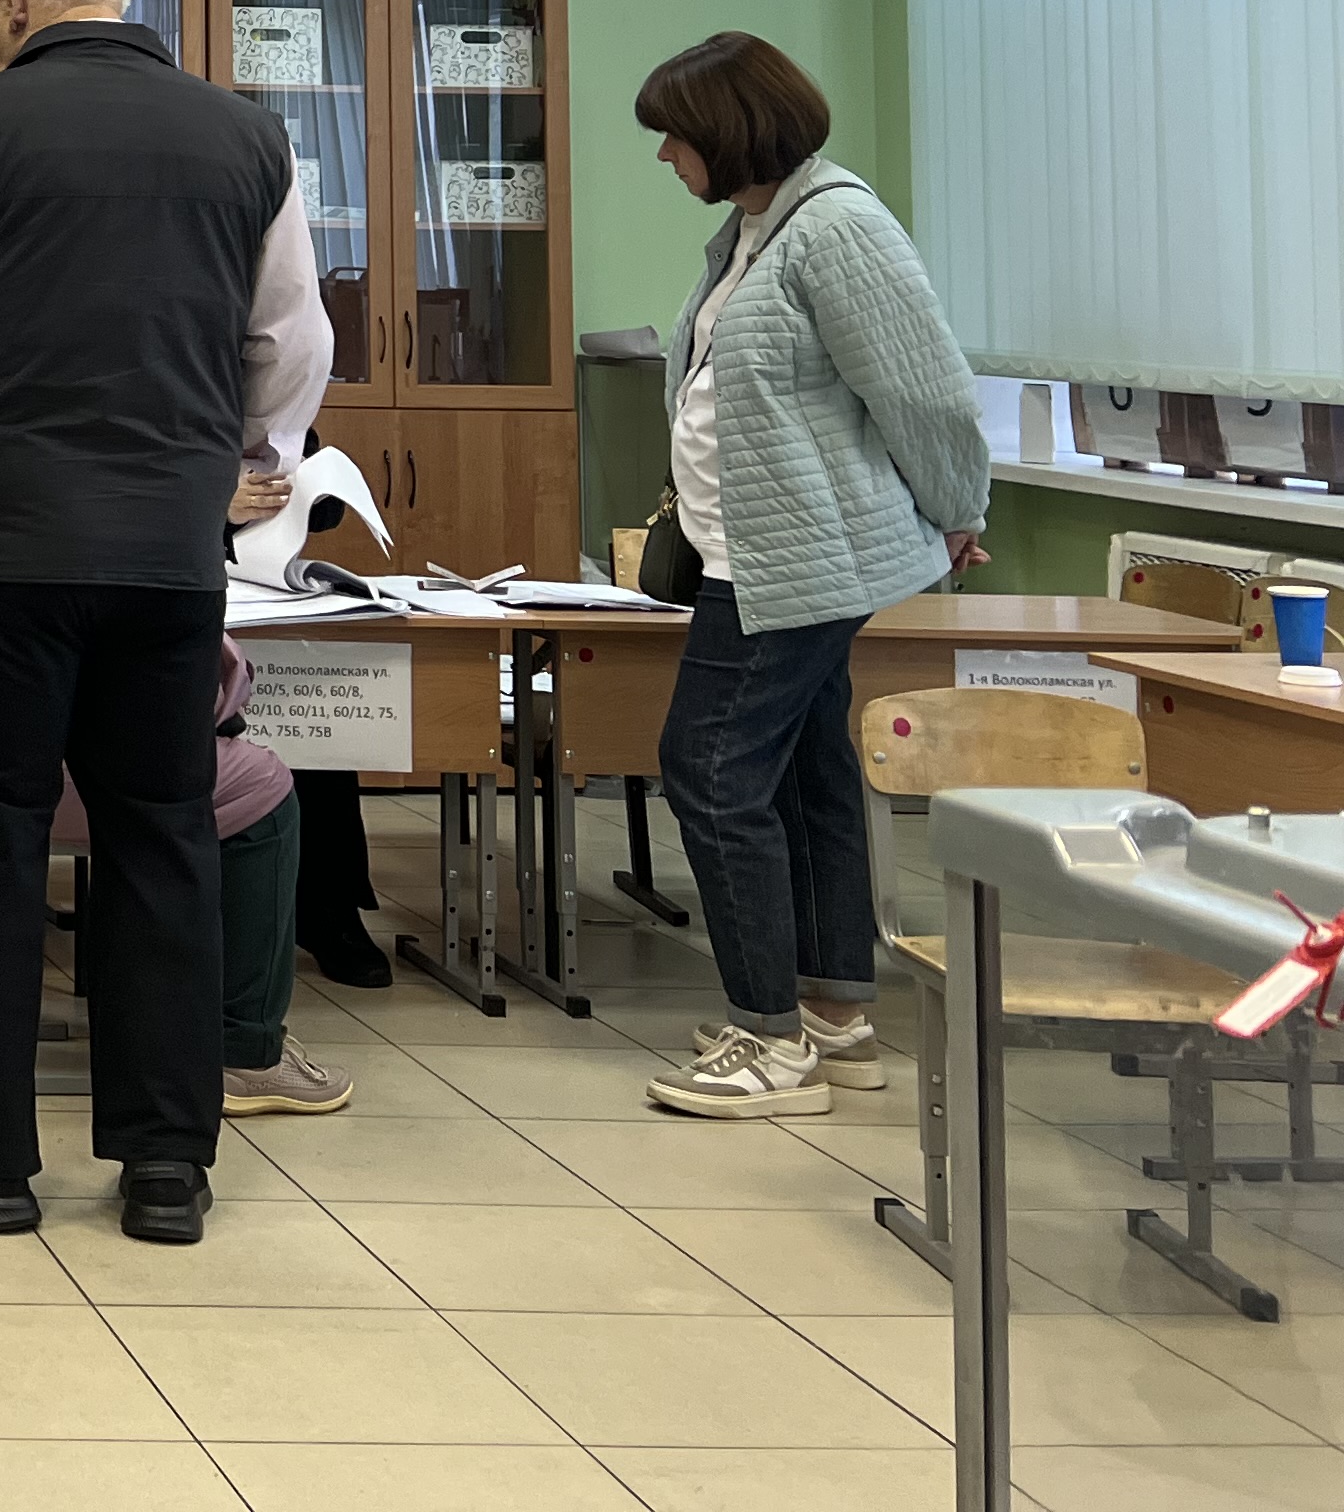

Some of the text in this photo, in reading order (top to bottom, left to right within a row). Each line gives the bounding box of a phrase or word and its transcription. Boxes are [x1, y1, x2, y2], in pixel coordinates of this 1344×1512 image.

[267, 664, 370, 677] Волоколамская
[372, 668, 392, 679] ул.
[968, 673, 1118, 691] 1-я Волоколамская ул.
[293, 684, 327, 699] 60/6,
[330, 685, 364, 699] 60/8,
[244, 704, 285, 718] 60/10,
[289, 705, 331, 719] 60/11,
[378, 707, 398, 720] 75,
